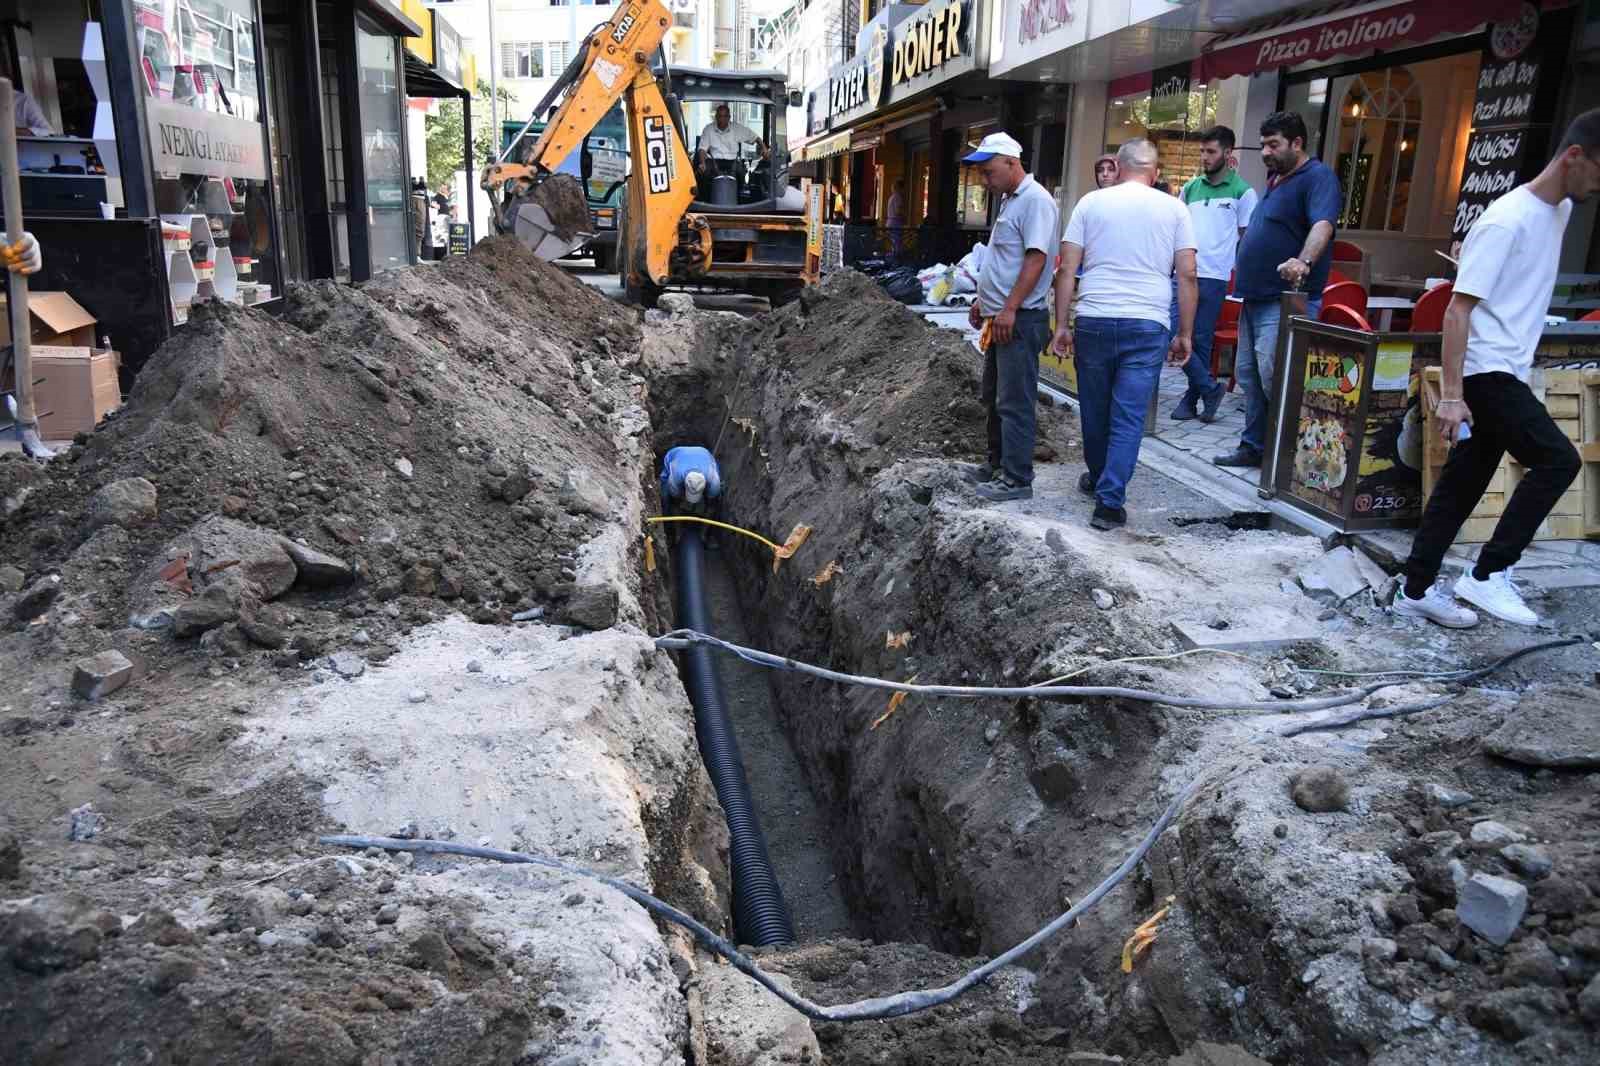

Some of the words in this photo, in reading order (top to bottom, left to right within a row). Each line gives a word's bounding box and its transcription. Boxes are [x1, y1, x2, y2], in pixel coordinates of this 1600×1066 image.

[892, 1, 961, 86] DÖNER
[1256, 39, 1311, 65] Pizza
[1315, 13, 1416, 51] italiano
[644, 116, 670, 193] JCB
